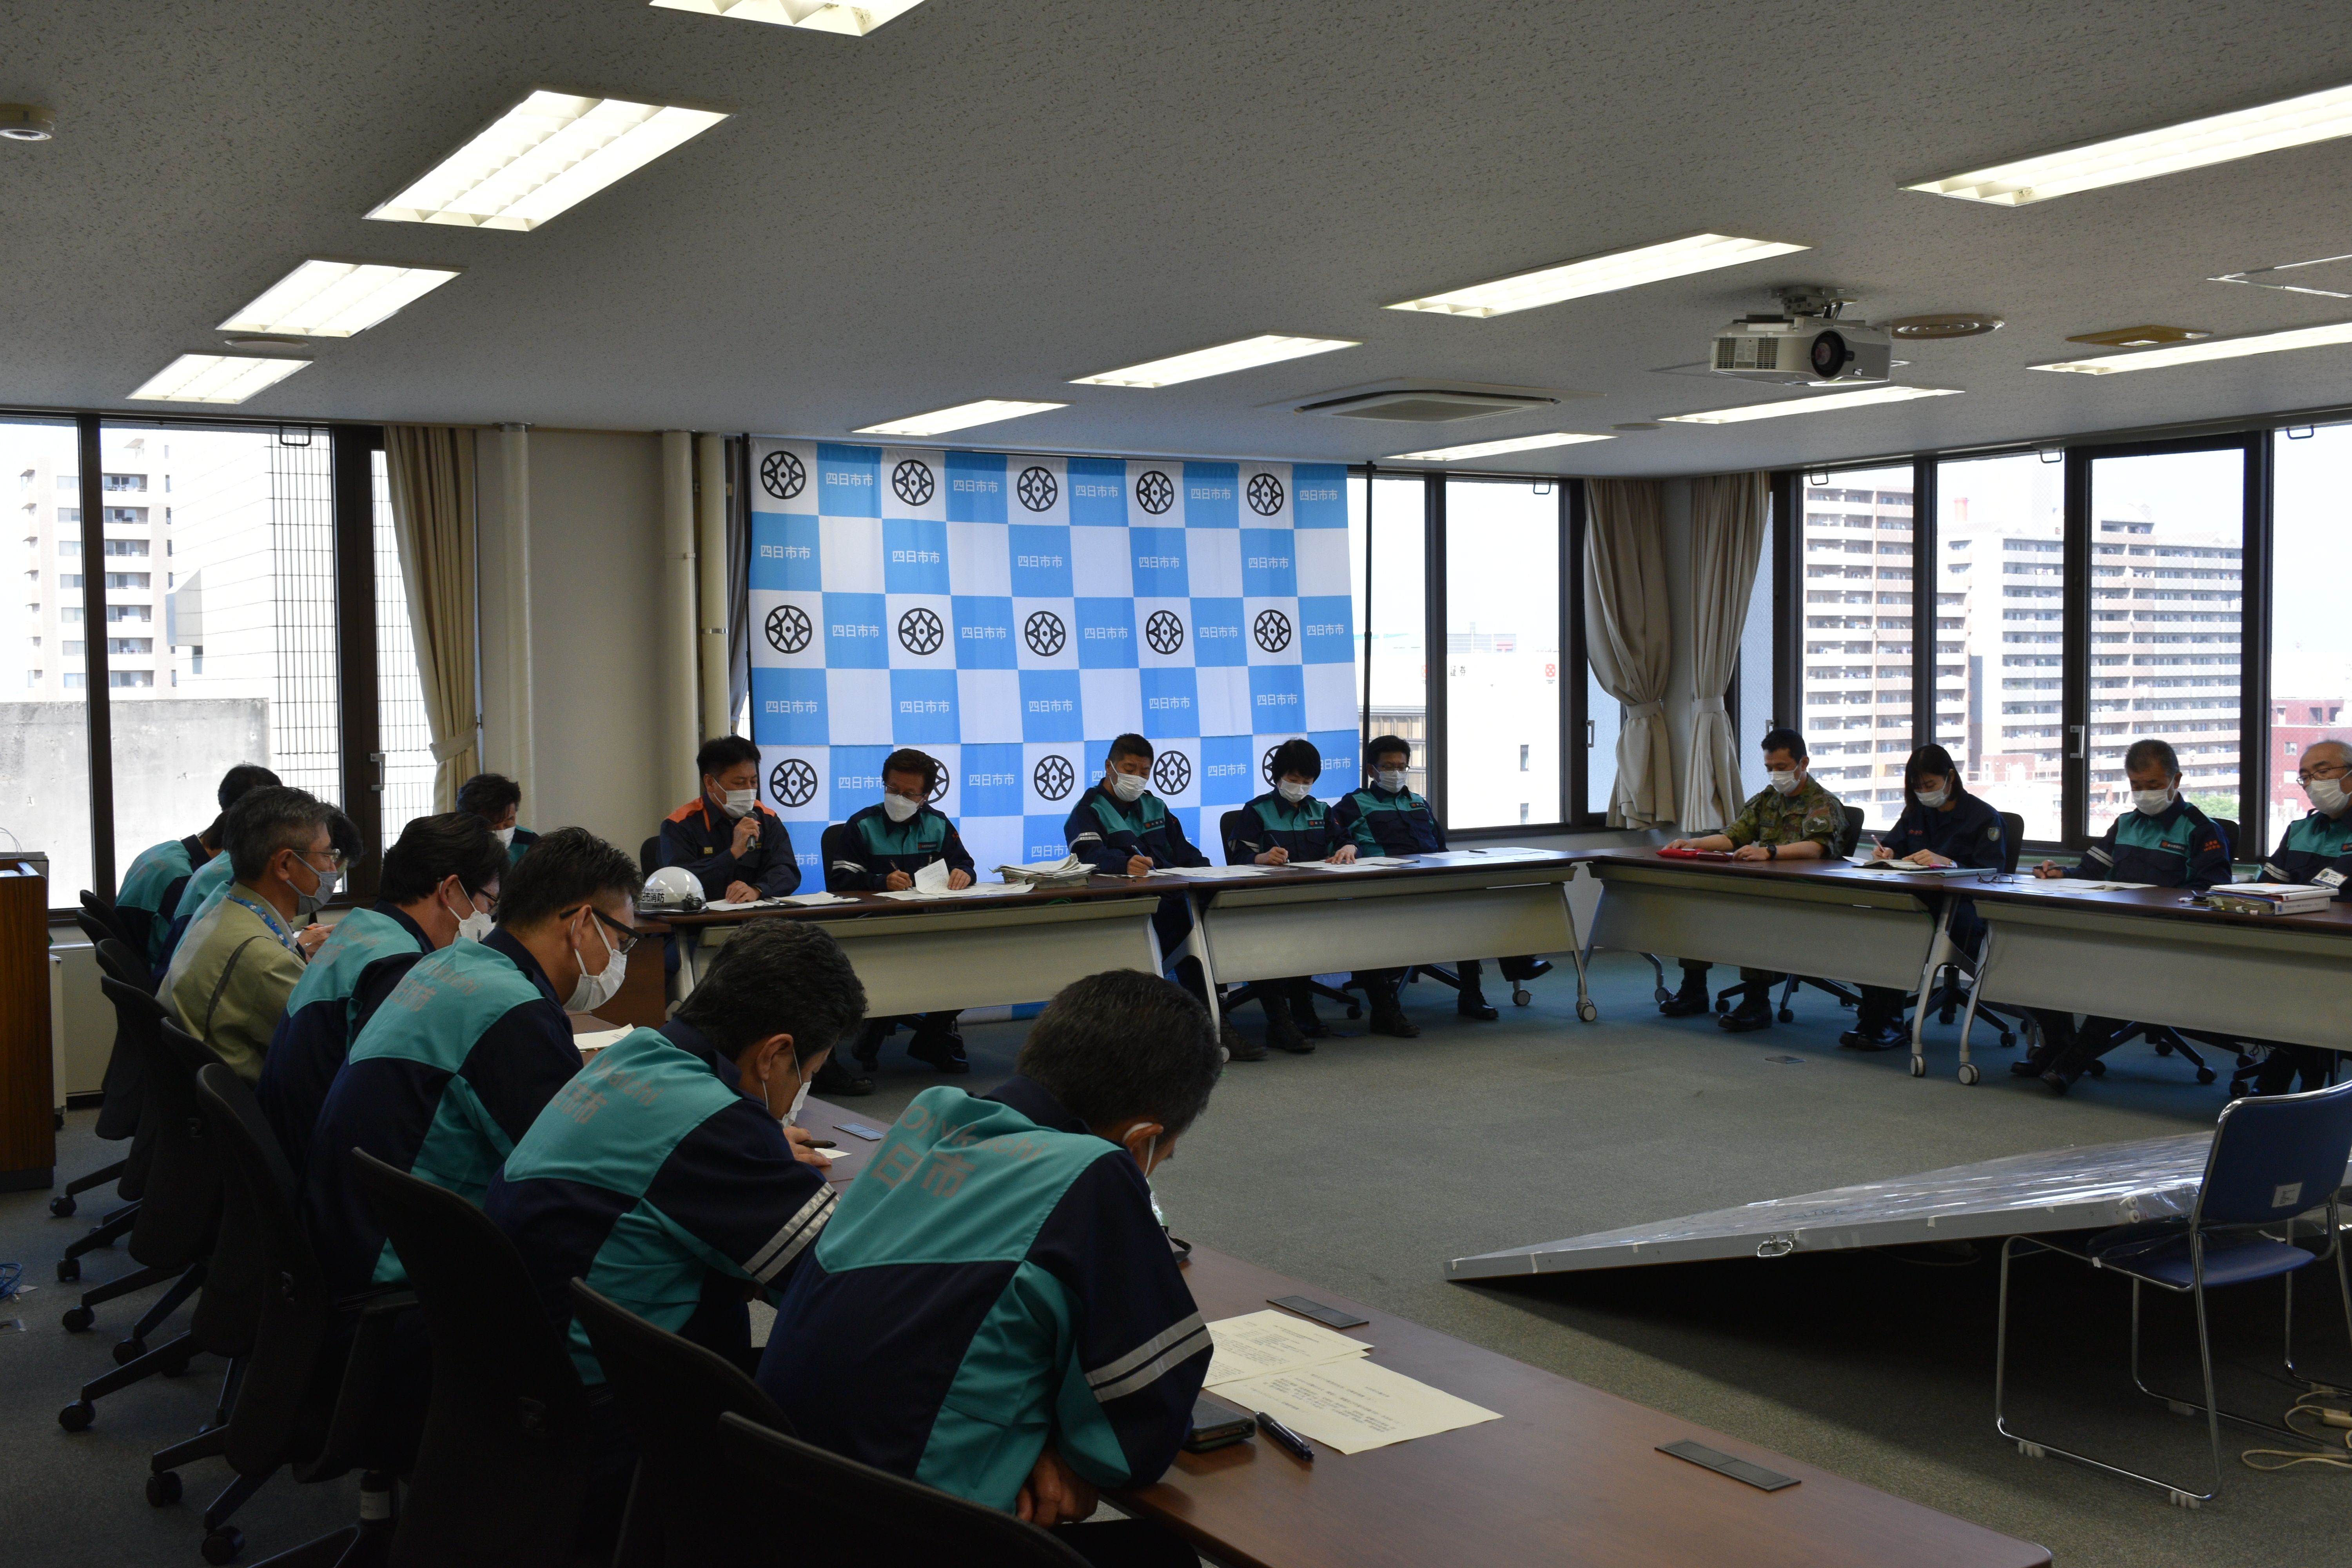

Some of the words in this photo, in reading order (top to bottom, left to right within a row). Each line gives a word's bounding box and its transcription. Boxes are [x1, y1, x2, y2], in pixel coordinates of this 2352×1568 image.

[826, 473, 872, 486] 四日市市
[954, 480, 998, 493] 四日市市
[1076, 485, 1118, 497] 四日市市
[1191, 488, 1230, 500] 四日市市
[1300, 490, 1337, 501] 四日市市
[761, 546, 811, 559] 四日市市
[893, 551, 939, 563] 四日市市
[1018, 555, 1062, 568] 四日市市
[1139, 556, 1179, 568] 四日市市
[1249, 557, 1288, 568] 四日市市
[833, 624, 879, 637] 四日市市
[962, 626, 1006, 639] 四日市市
[1085, 627, 1127, 639] 四日市市
[1200, 626, 1238, 638] 四日市市
[1307, 624, 1344, 635] 四日市市
[1150, 697, 1190, 709] 四日市市
[1257, 693, 1297, 706] 四日市市
[766, 701, 818, 713] 四日市市
[900, 701, 949, 713] 四日市市
[1029, 700, 1073, 712] 四日市市
[1208, 763, 1246, 777] 四日市市
[839, 775, 884, 789] 四日市市
[969, 773, 1014, 786] 四日市市
[1092, 771, 1106, 782] 四
